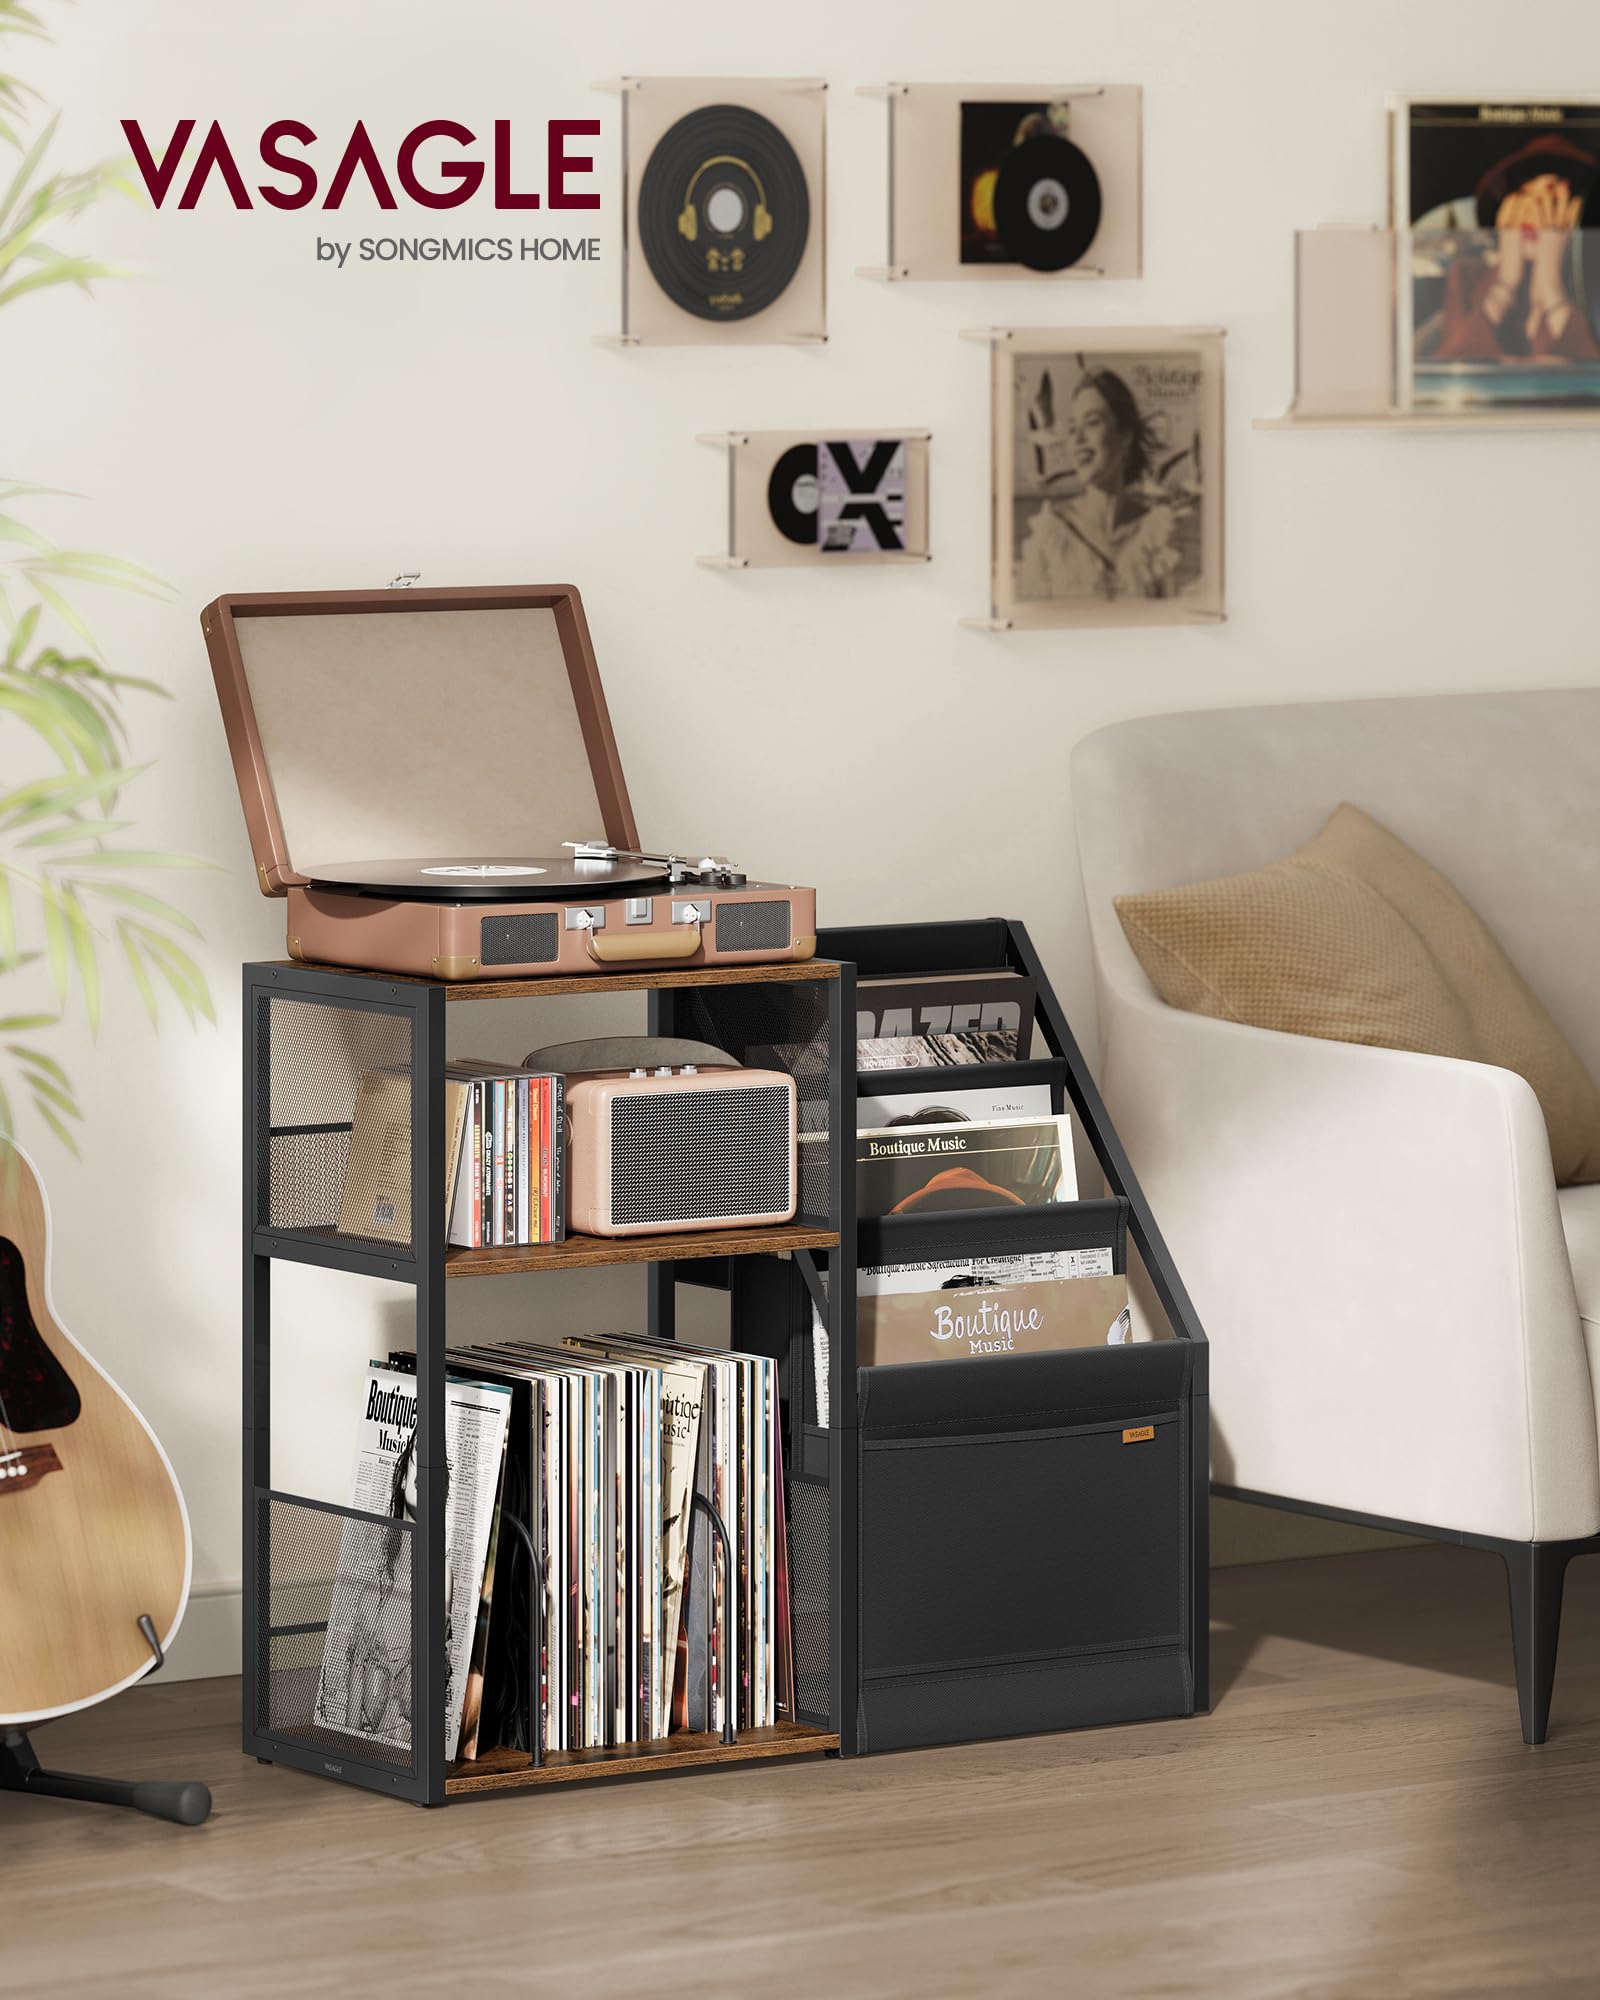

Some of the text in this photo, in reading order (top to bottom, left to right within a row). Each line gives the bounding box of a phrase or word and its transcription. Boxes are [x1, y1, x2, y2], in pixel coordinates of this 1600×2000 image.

[869, 1135, 967, 1156] Boutique Music
[929, 1300, 1044, 1340] Boutique
[968, 1337, 1015, 1354] Music
[365, 1379, 417, 1435] Boutique
[663, 1421, 688, 1439] usic
